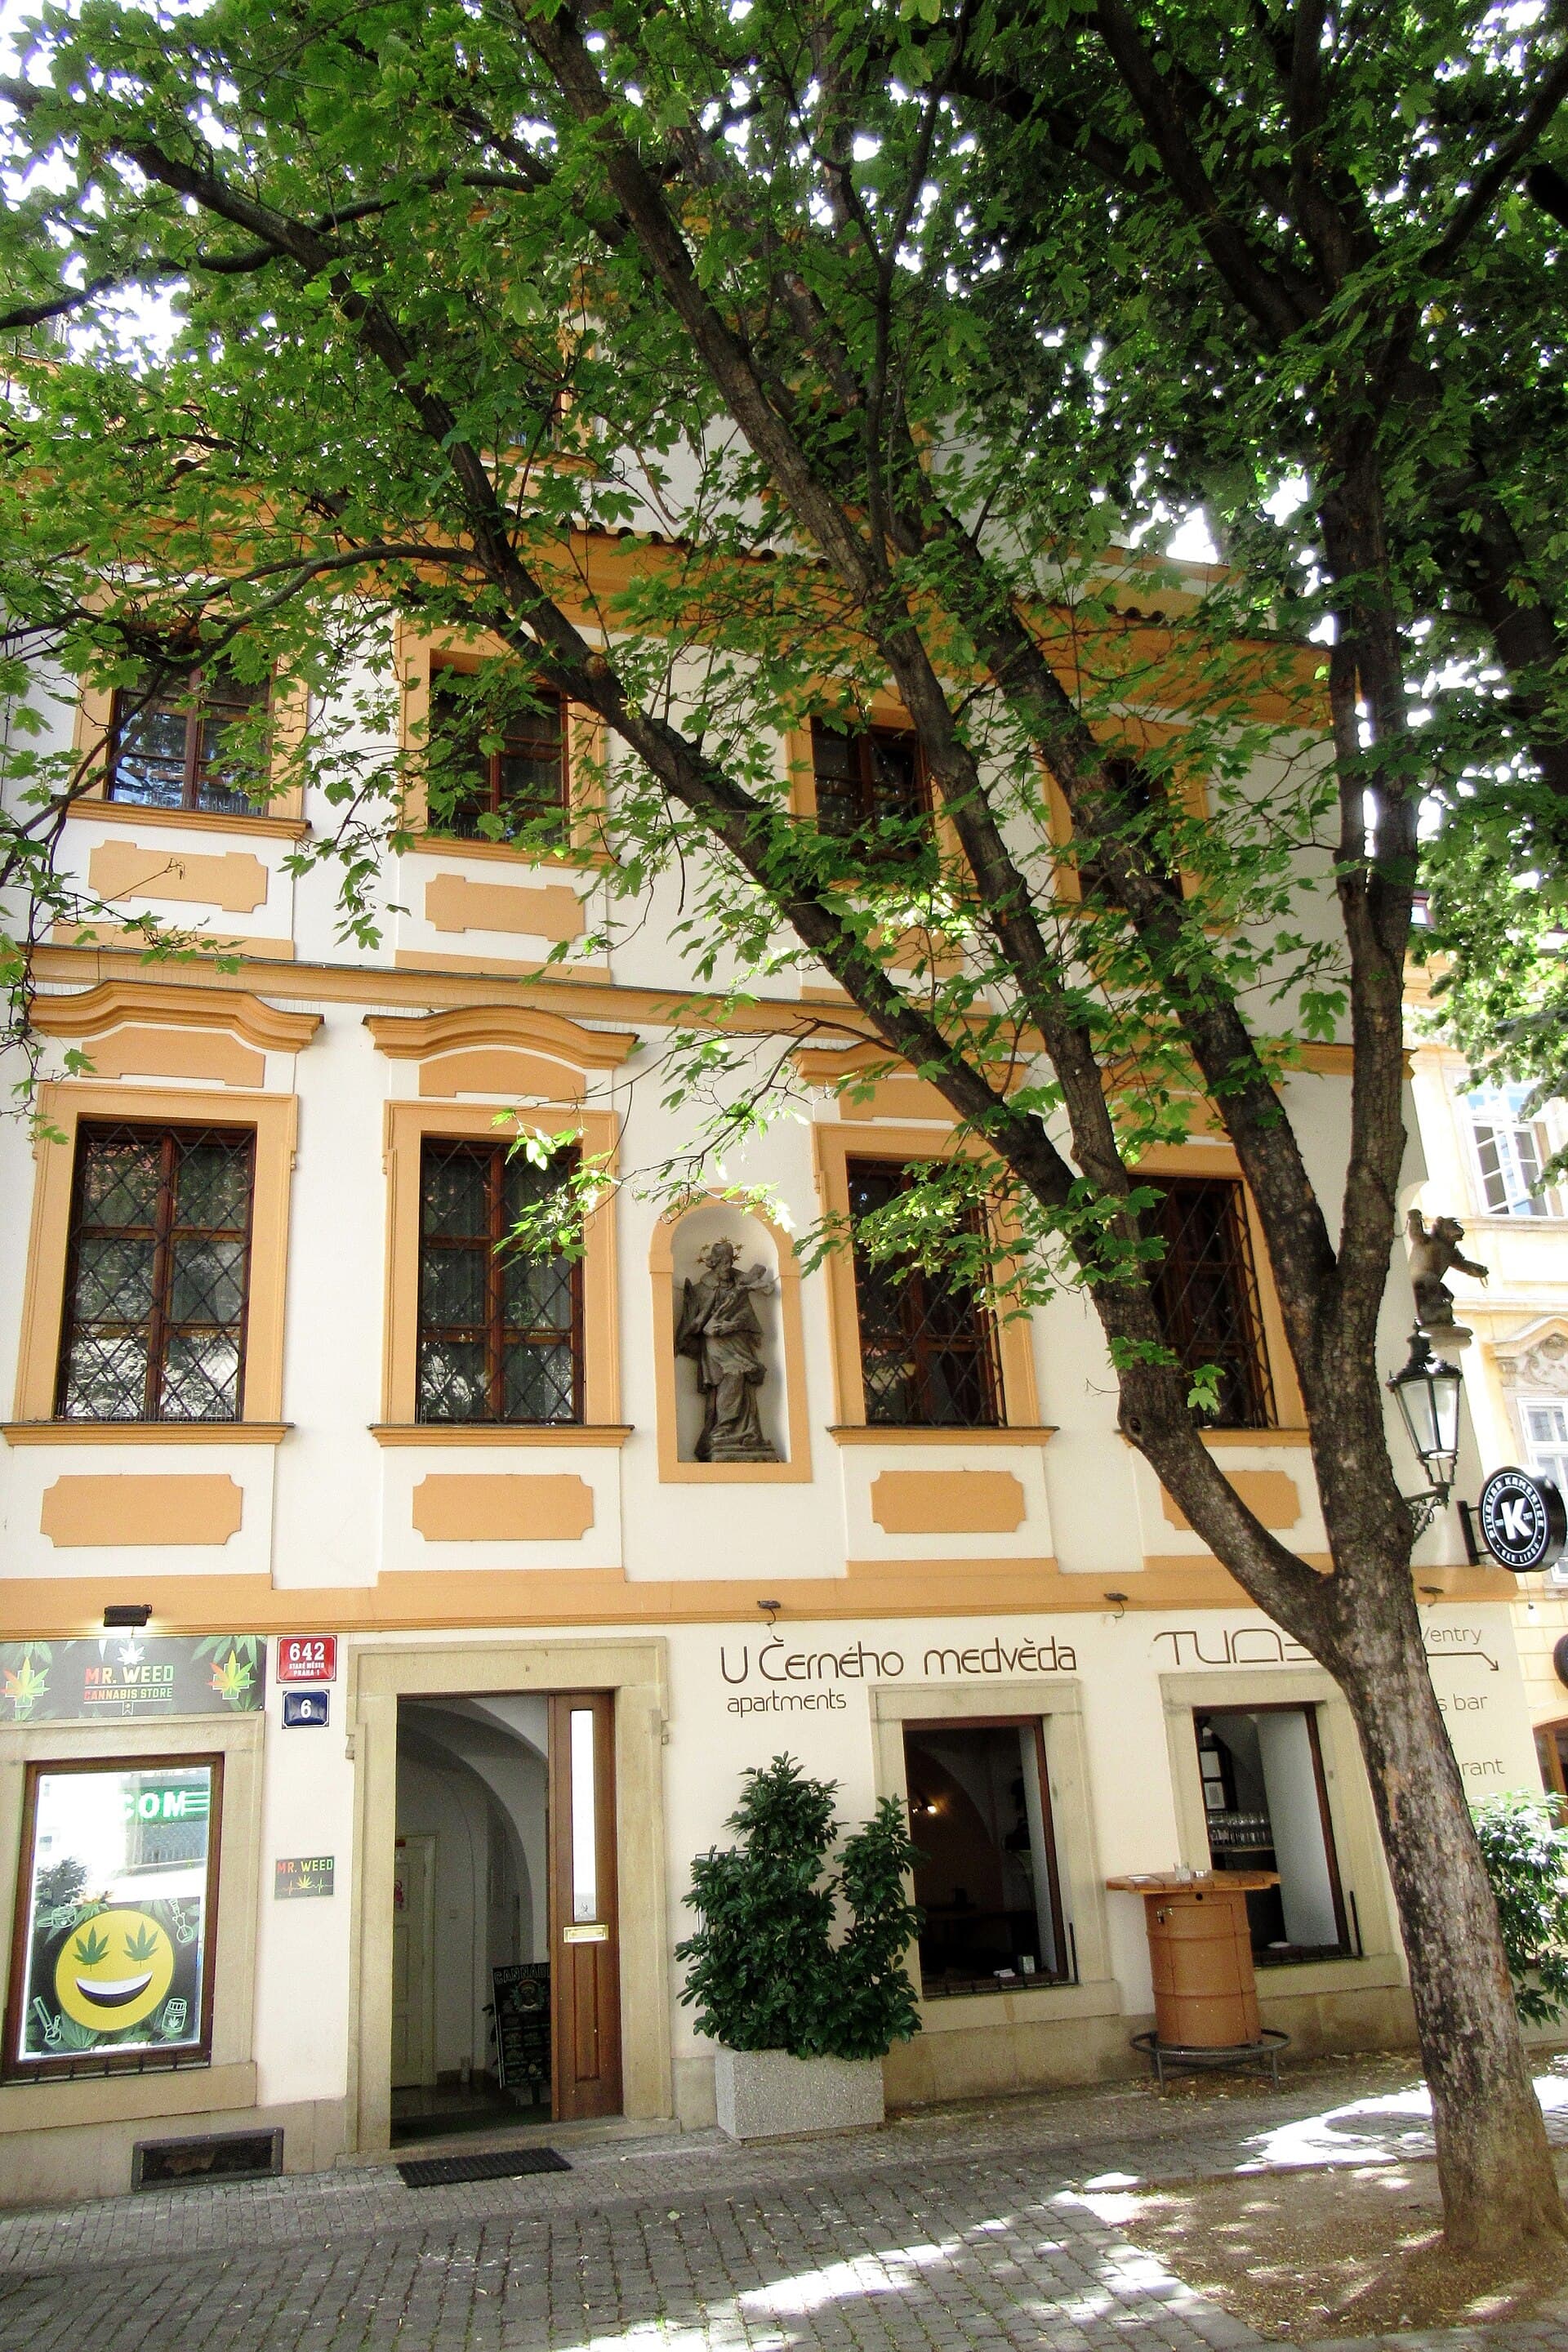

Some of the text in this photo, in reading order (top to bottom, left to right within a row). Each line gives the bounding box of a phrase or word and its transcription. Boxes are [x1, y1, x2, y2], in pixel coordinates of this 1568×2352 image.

[1500, 1497, 1534, 1540] K
[289, 1642, 325, 1661] 642
[720, 1634, 1077, 1685] U Černého medvěda
[85, 1665, 174, 1685] MR. WEED
[288, 1661, 325, 1670] STARÉ MĚSTO
[84, 1687, 173, 1701] CANNABIS STORE
[726, 1687, 848, 1718] apartments
[1453, 1693, 1490, 1711] bar
[301, 1699, 312, 1718] 6
[277, 1859, 333, 1874] MR. WEED
